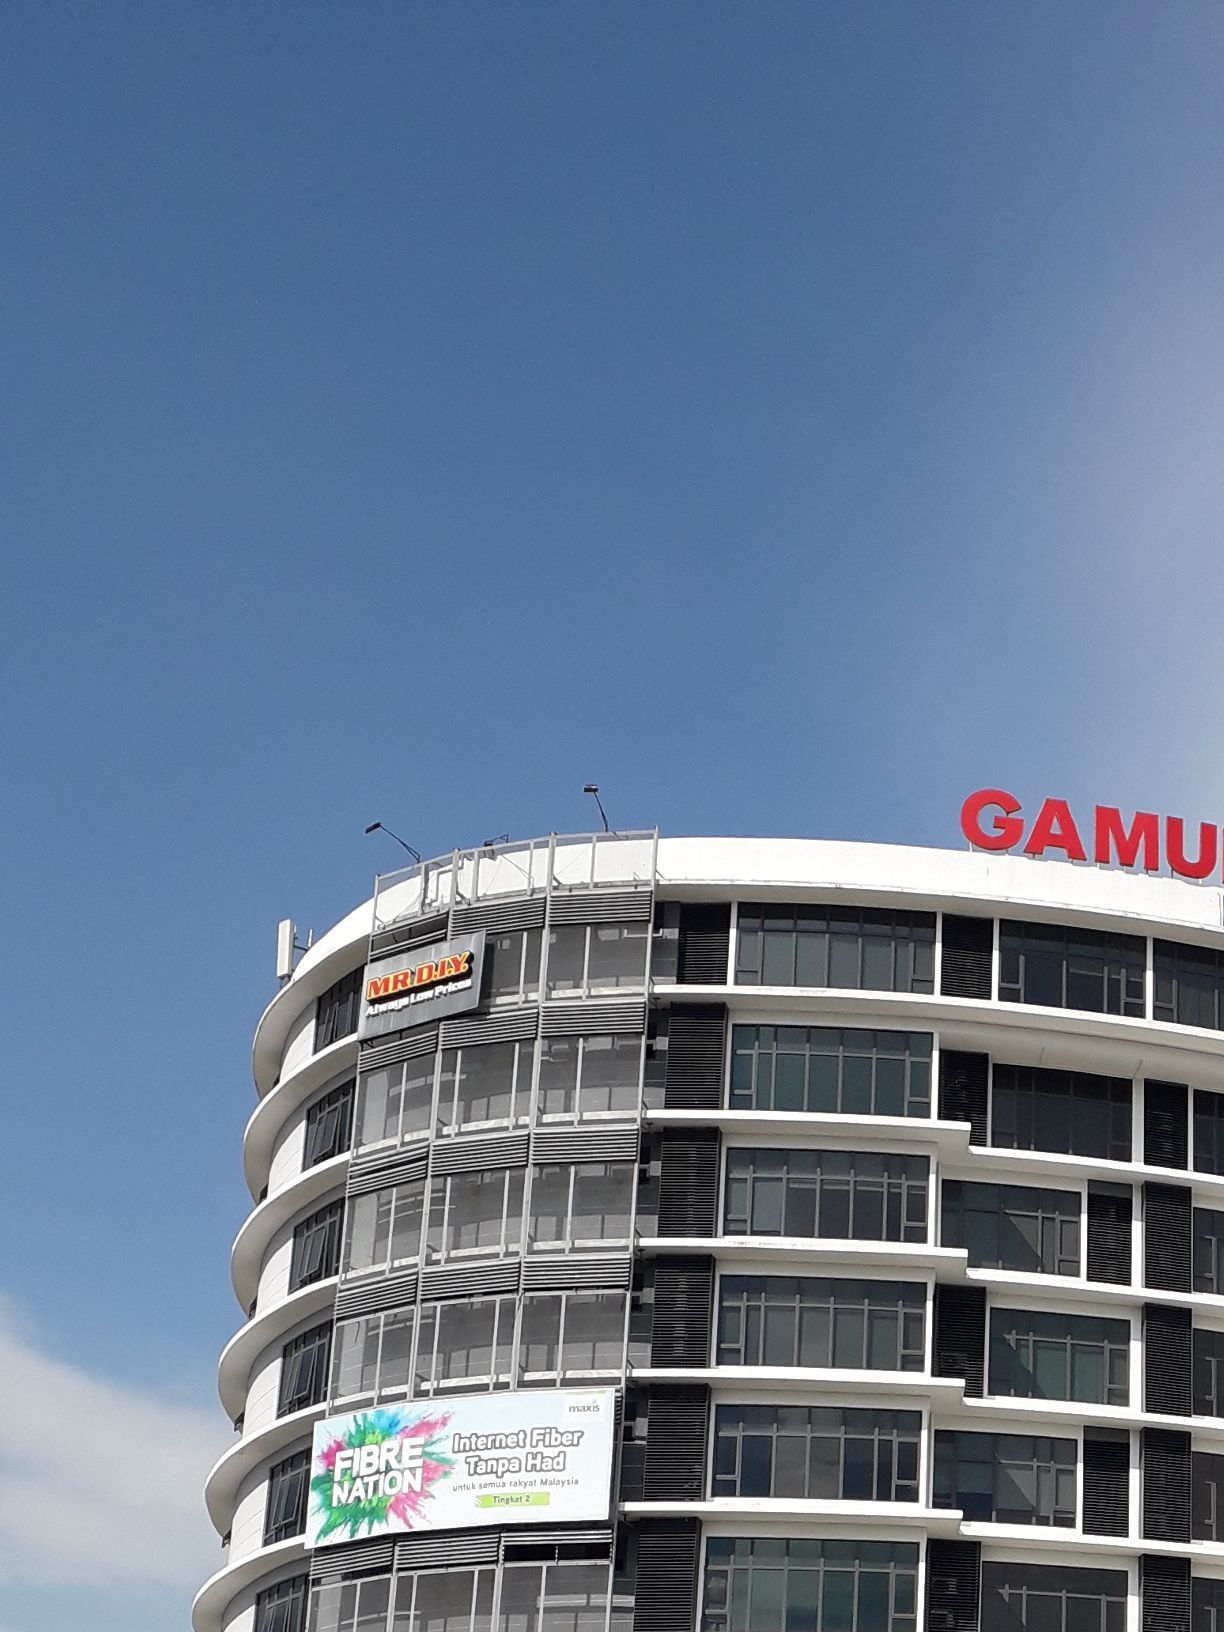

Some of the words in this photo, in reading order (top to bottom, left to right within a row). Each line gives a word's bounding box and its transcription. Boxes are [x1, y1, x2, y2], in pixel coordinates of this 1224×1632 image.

[365, 997, 409, 1017] Always
[410, 989, 434, 1004] Low
[434, 979, 472, 998] Prices
[568, 1400, 601, 1413] maxis
[452, 1430, 527, 1453] Internet
[530, 1427, 584, 1450] Fiber
[333, 1437, 426, 1483] FIBRE
[465, 1454, 519, 1478] Tanpa
[526, 1452, 565, 1474] Had
[331, 1467, 424, 1508] NATION
[452, 1482, 477, 1492] untuk
[478, 1480, 506, 1490] semua
[508, 1478, 537, 1489] rakyat
[540, 1477, 580, 1488] Malaysia
[492, 1495, 524, 1506] Tingkat
[525, 1495, 531, 1504] 2
